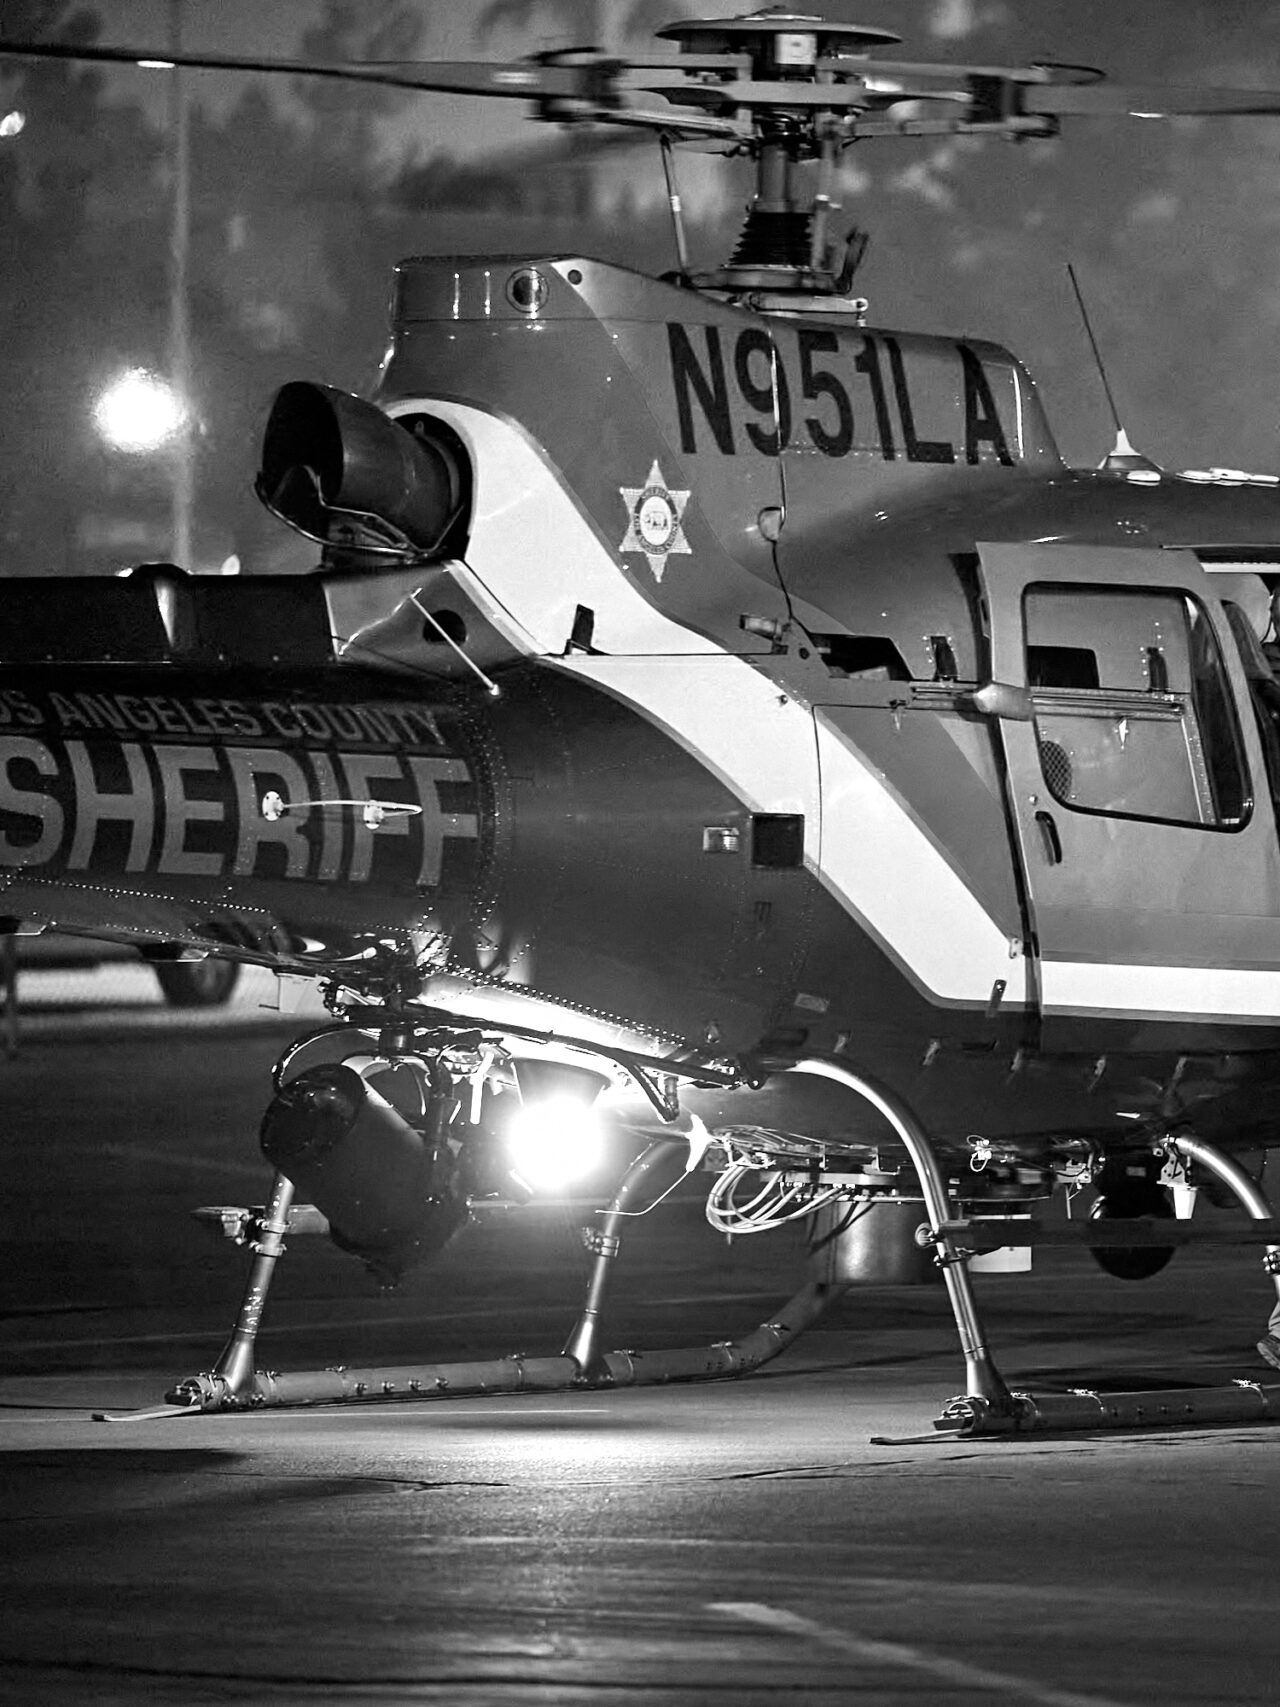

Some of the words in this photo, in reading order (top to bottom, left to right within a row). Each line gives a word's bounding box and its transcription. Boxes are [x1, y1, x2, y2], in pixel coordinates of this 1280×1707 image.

[667, 322, 1015, 467] N951LA
[48, 691, 262, 736] ANGELES
[261, 702, 446, 745] COUNTY
[0, 735, 478, 887] SHERIFF
